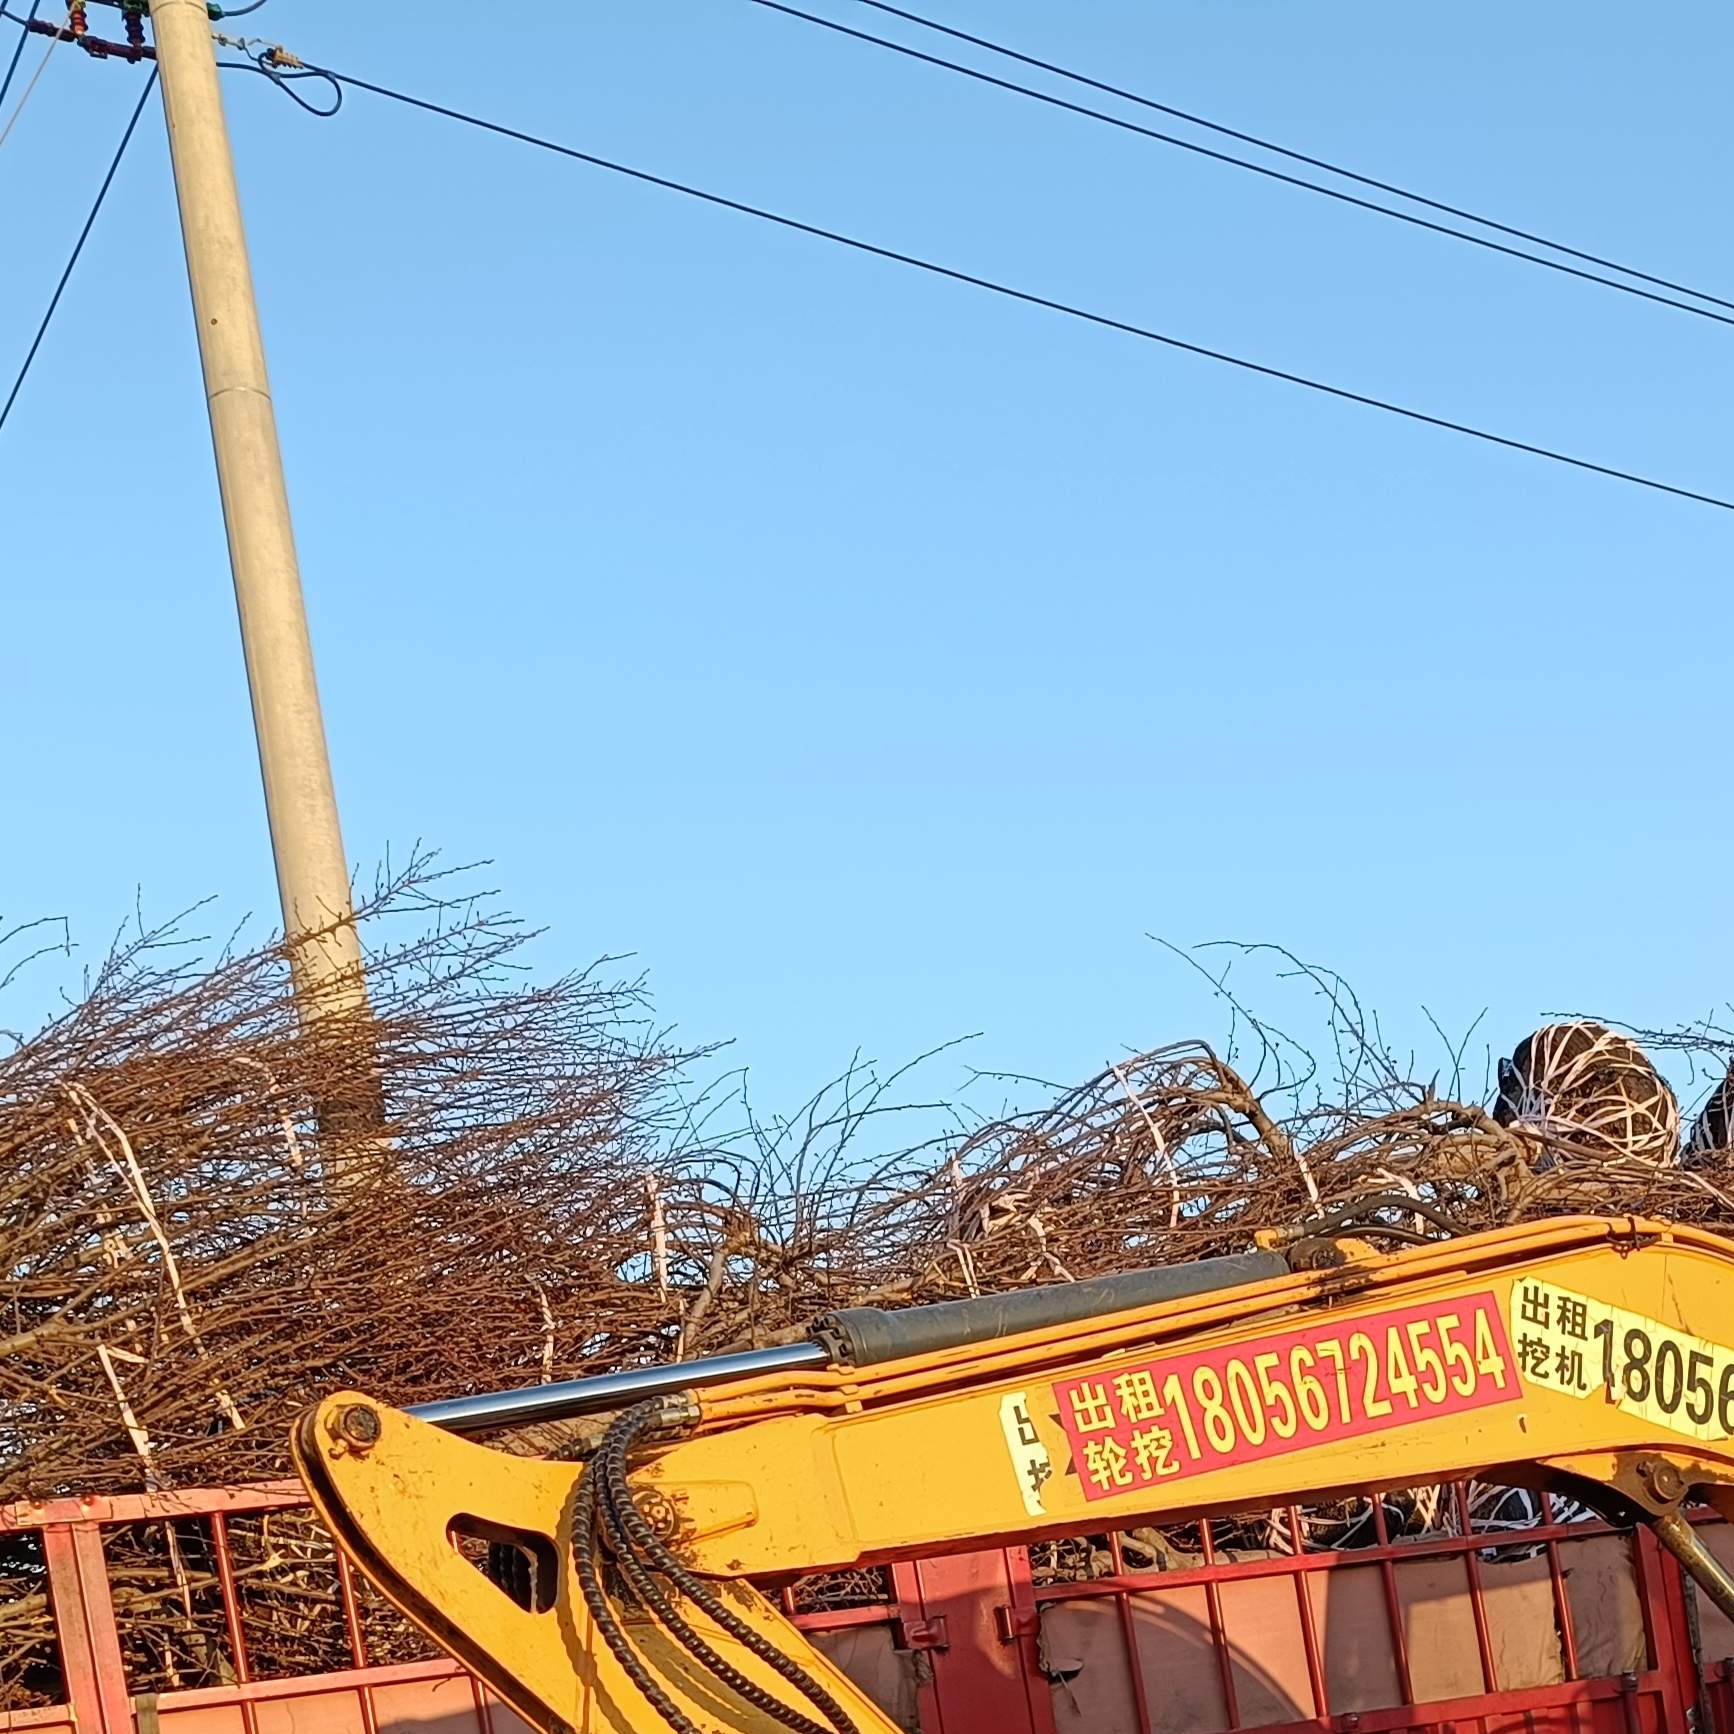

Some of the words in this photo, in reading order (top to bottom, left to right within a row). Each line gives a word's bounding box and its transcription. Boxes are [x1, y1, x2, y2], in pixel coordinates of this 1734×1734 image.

[1520, 1285, 1589, 1342] 出租
[1162, 1307, 1507, 1460] 18056724554
[1517, 1332, 1588, 1391] 挖机
[1068, 1369, 1166, 1434] 出租
[1082, 1424, 1181, 1491] 轮挖
